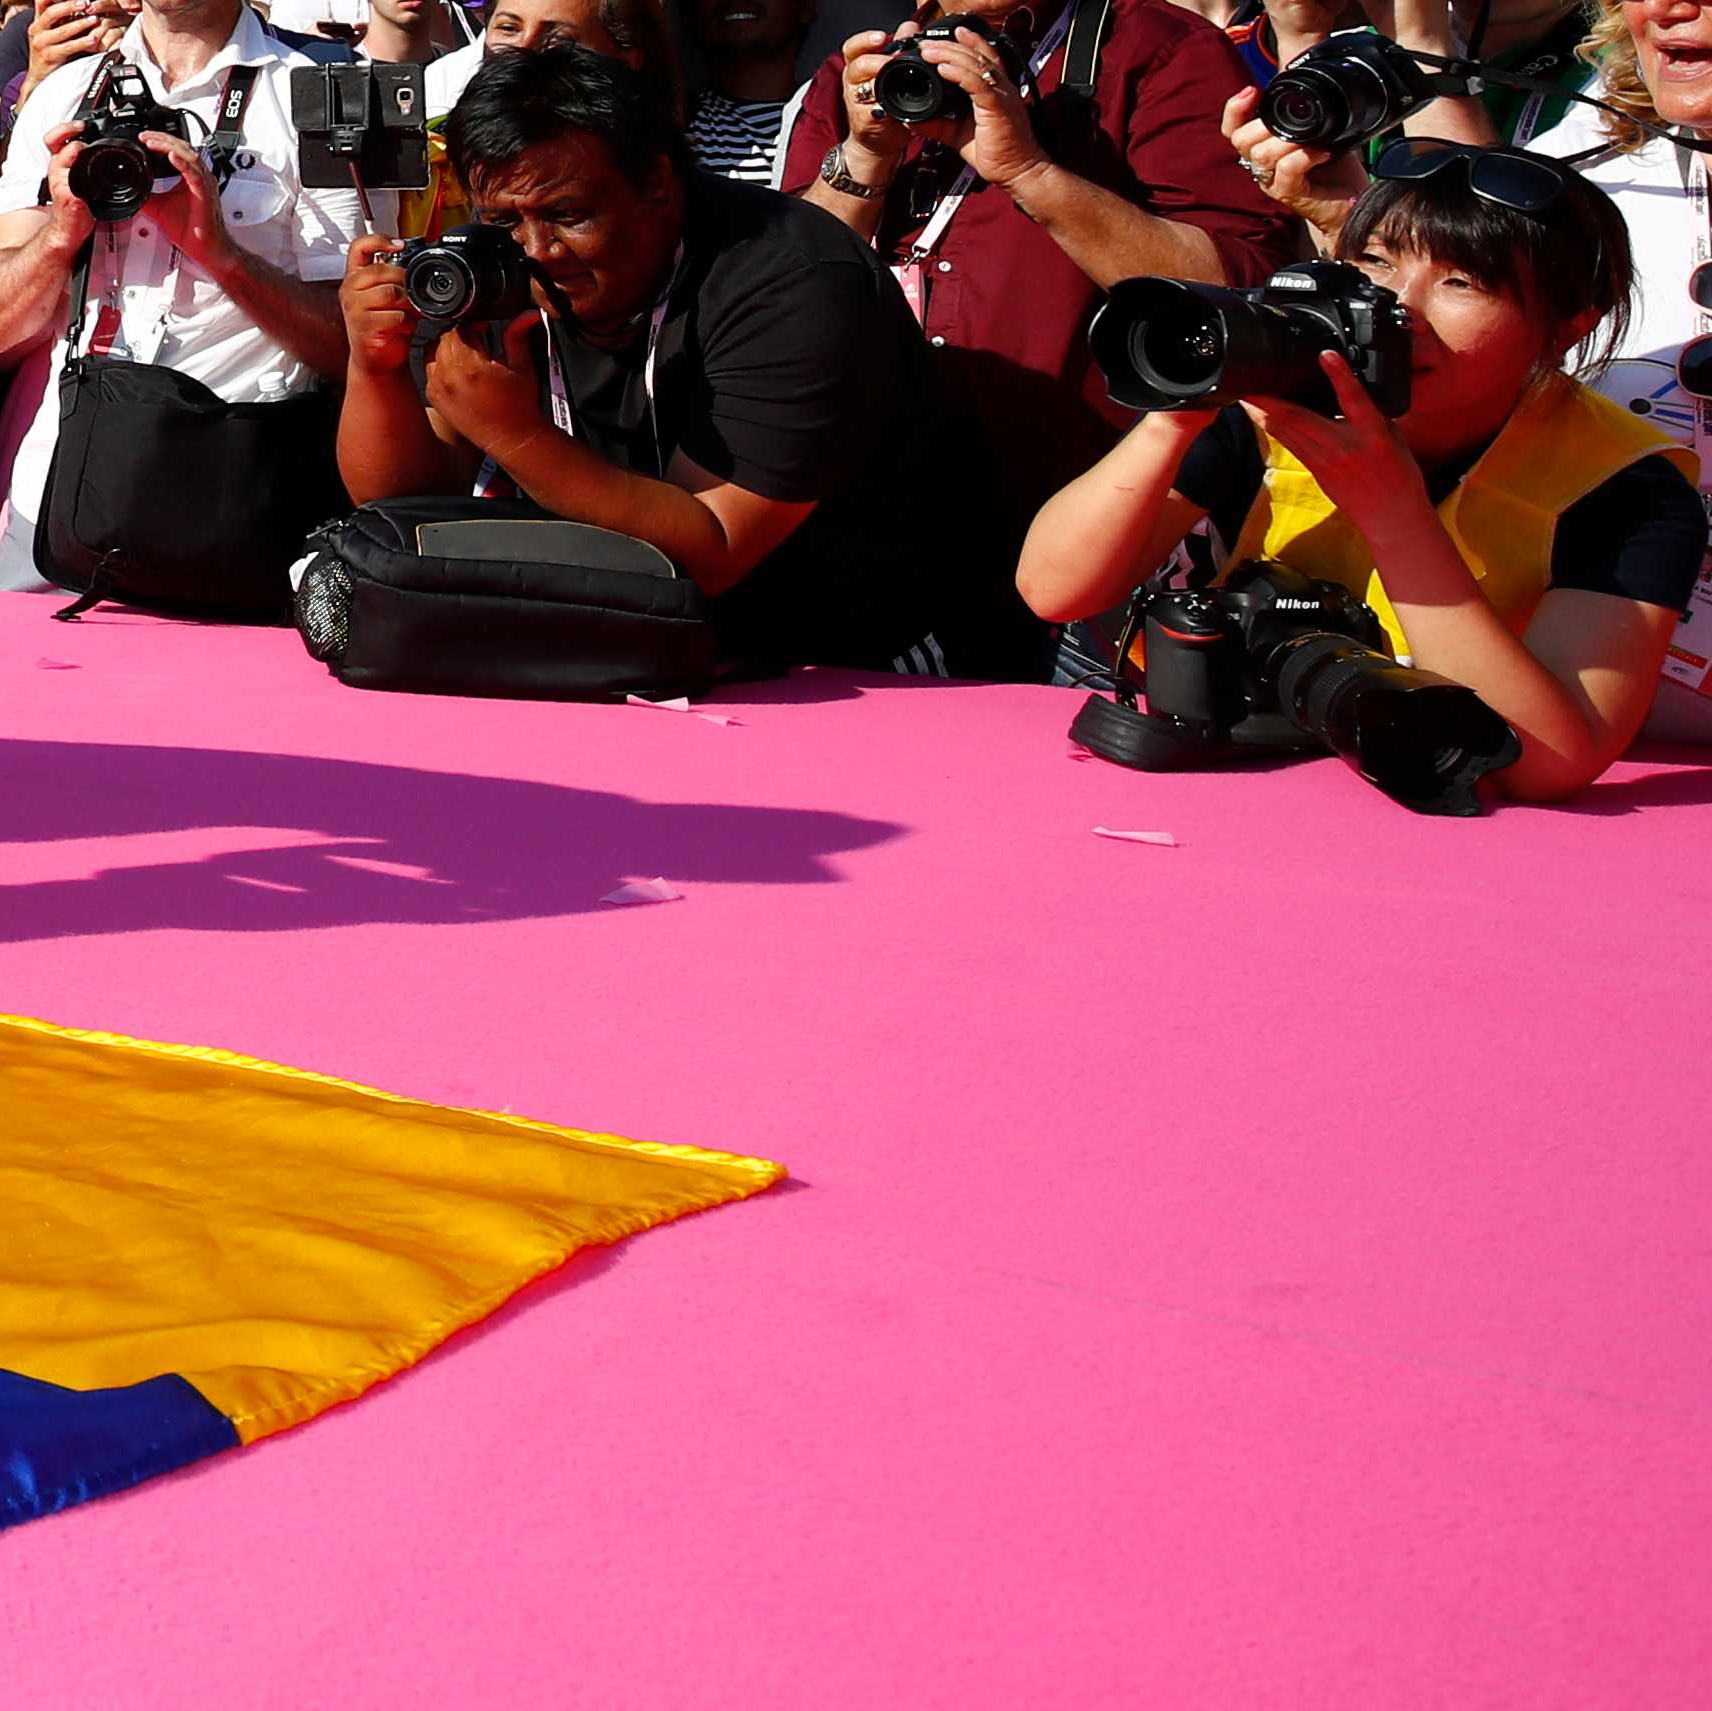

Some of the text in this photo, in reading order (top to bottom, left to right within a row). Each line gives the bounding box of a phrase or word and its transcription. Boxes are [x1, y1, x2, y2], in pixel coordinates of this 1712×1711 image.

[226, 89, 243, 118] EOS
[442, 235, 468, 243] SONY
[1269, 276, 1312, 289] Nikon
[1275, 598, 1320, 610] Nikon
